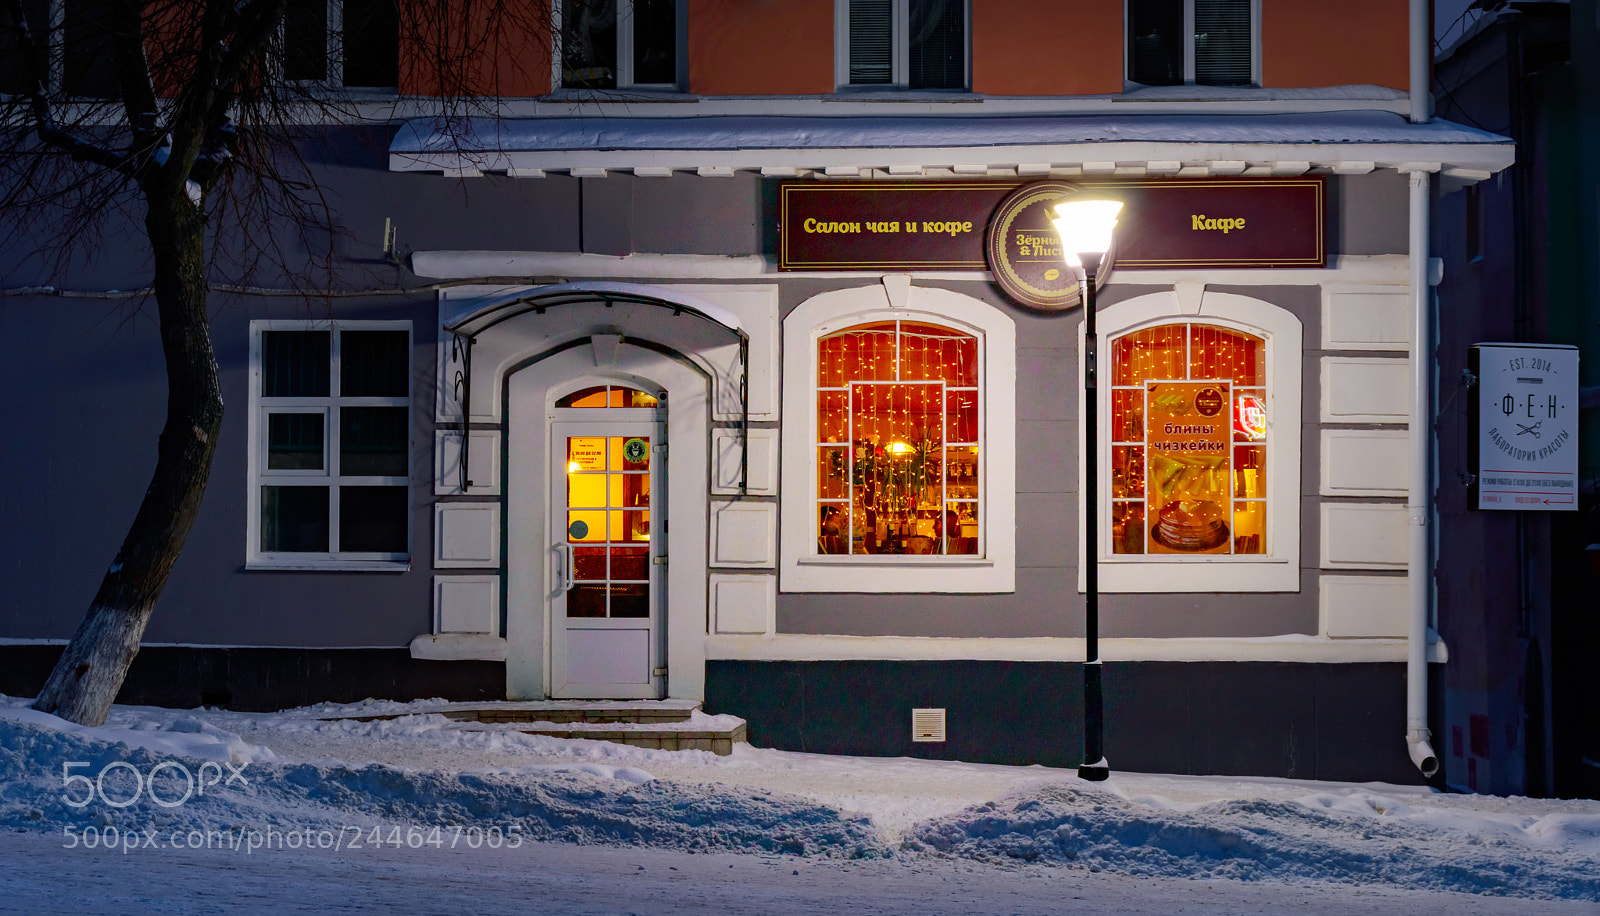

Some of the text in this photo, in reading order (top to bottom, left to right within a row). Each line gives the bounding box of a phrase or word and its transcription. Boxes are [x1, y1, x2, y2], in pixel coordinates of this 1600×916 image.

[803, 217, 973, 237] Салон чая и кофе
[1191, 214, 1246, 234] Кафе
[1016, 234, 1062, 248] Зёрны
[1509, 357, 1552, 373] EST. 2014
[1164, 422, 1214, 434] блины
[1153, 439, 1225, 451] чизкейки
[1488, 427, 1569, 461] ЛАБОРАТОРИЯ КРАСОТЫ
